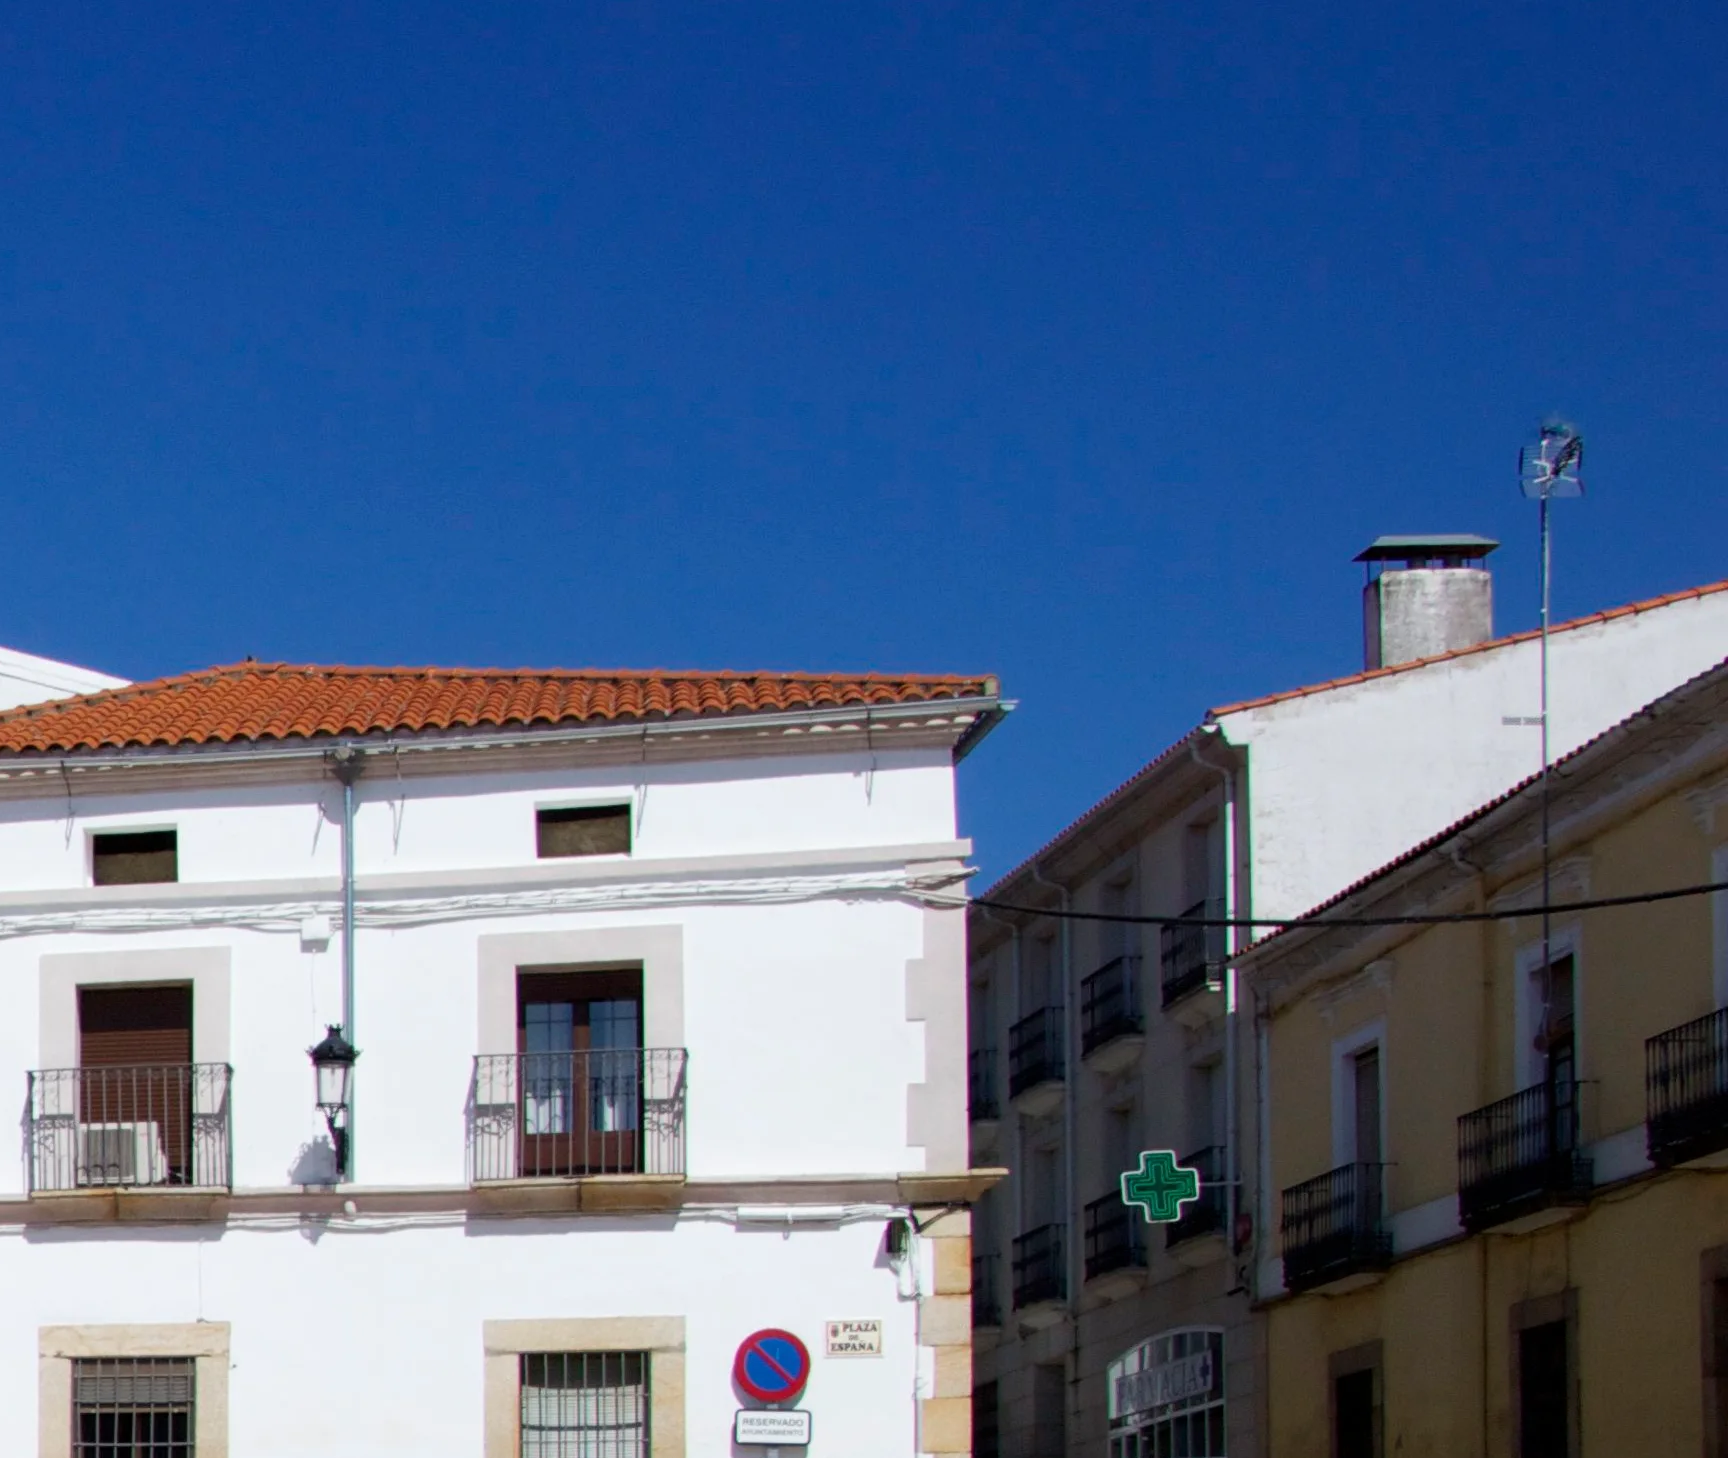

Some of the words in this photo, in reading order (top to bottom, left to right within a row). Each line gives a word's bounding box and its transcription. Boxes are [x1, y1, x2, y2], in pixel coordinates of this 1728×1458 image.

[842, 1322, 877, 1332] PLAZA
[831, 1340, 874, 1352] ESPAÑA
[1117, 1362, 1198, 1413] FARMACIA
[742, 1418, 804, 1427] RESERVADO
[741, 1428, 804, 1436] AYUNTAMIENTO
